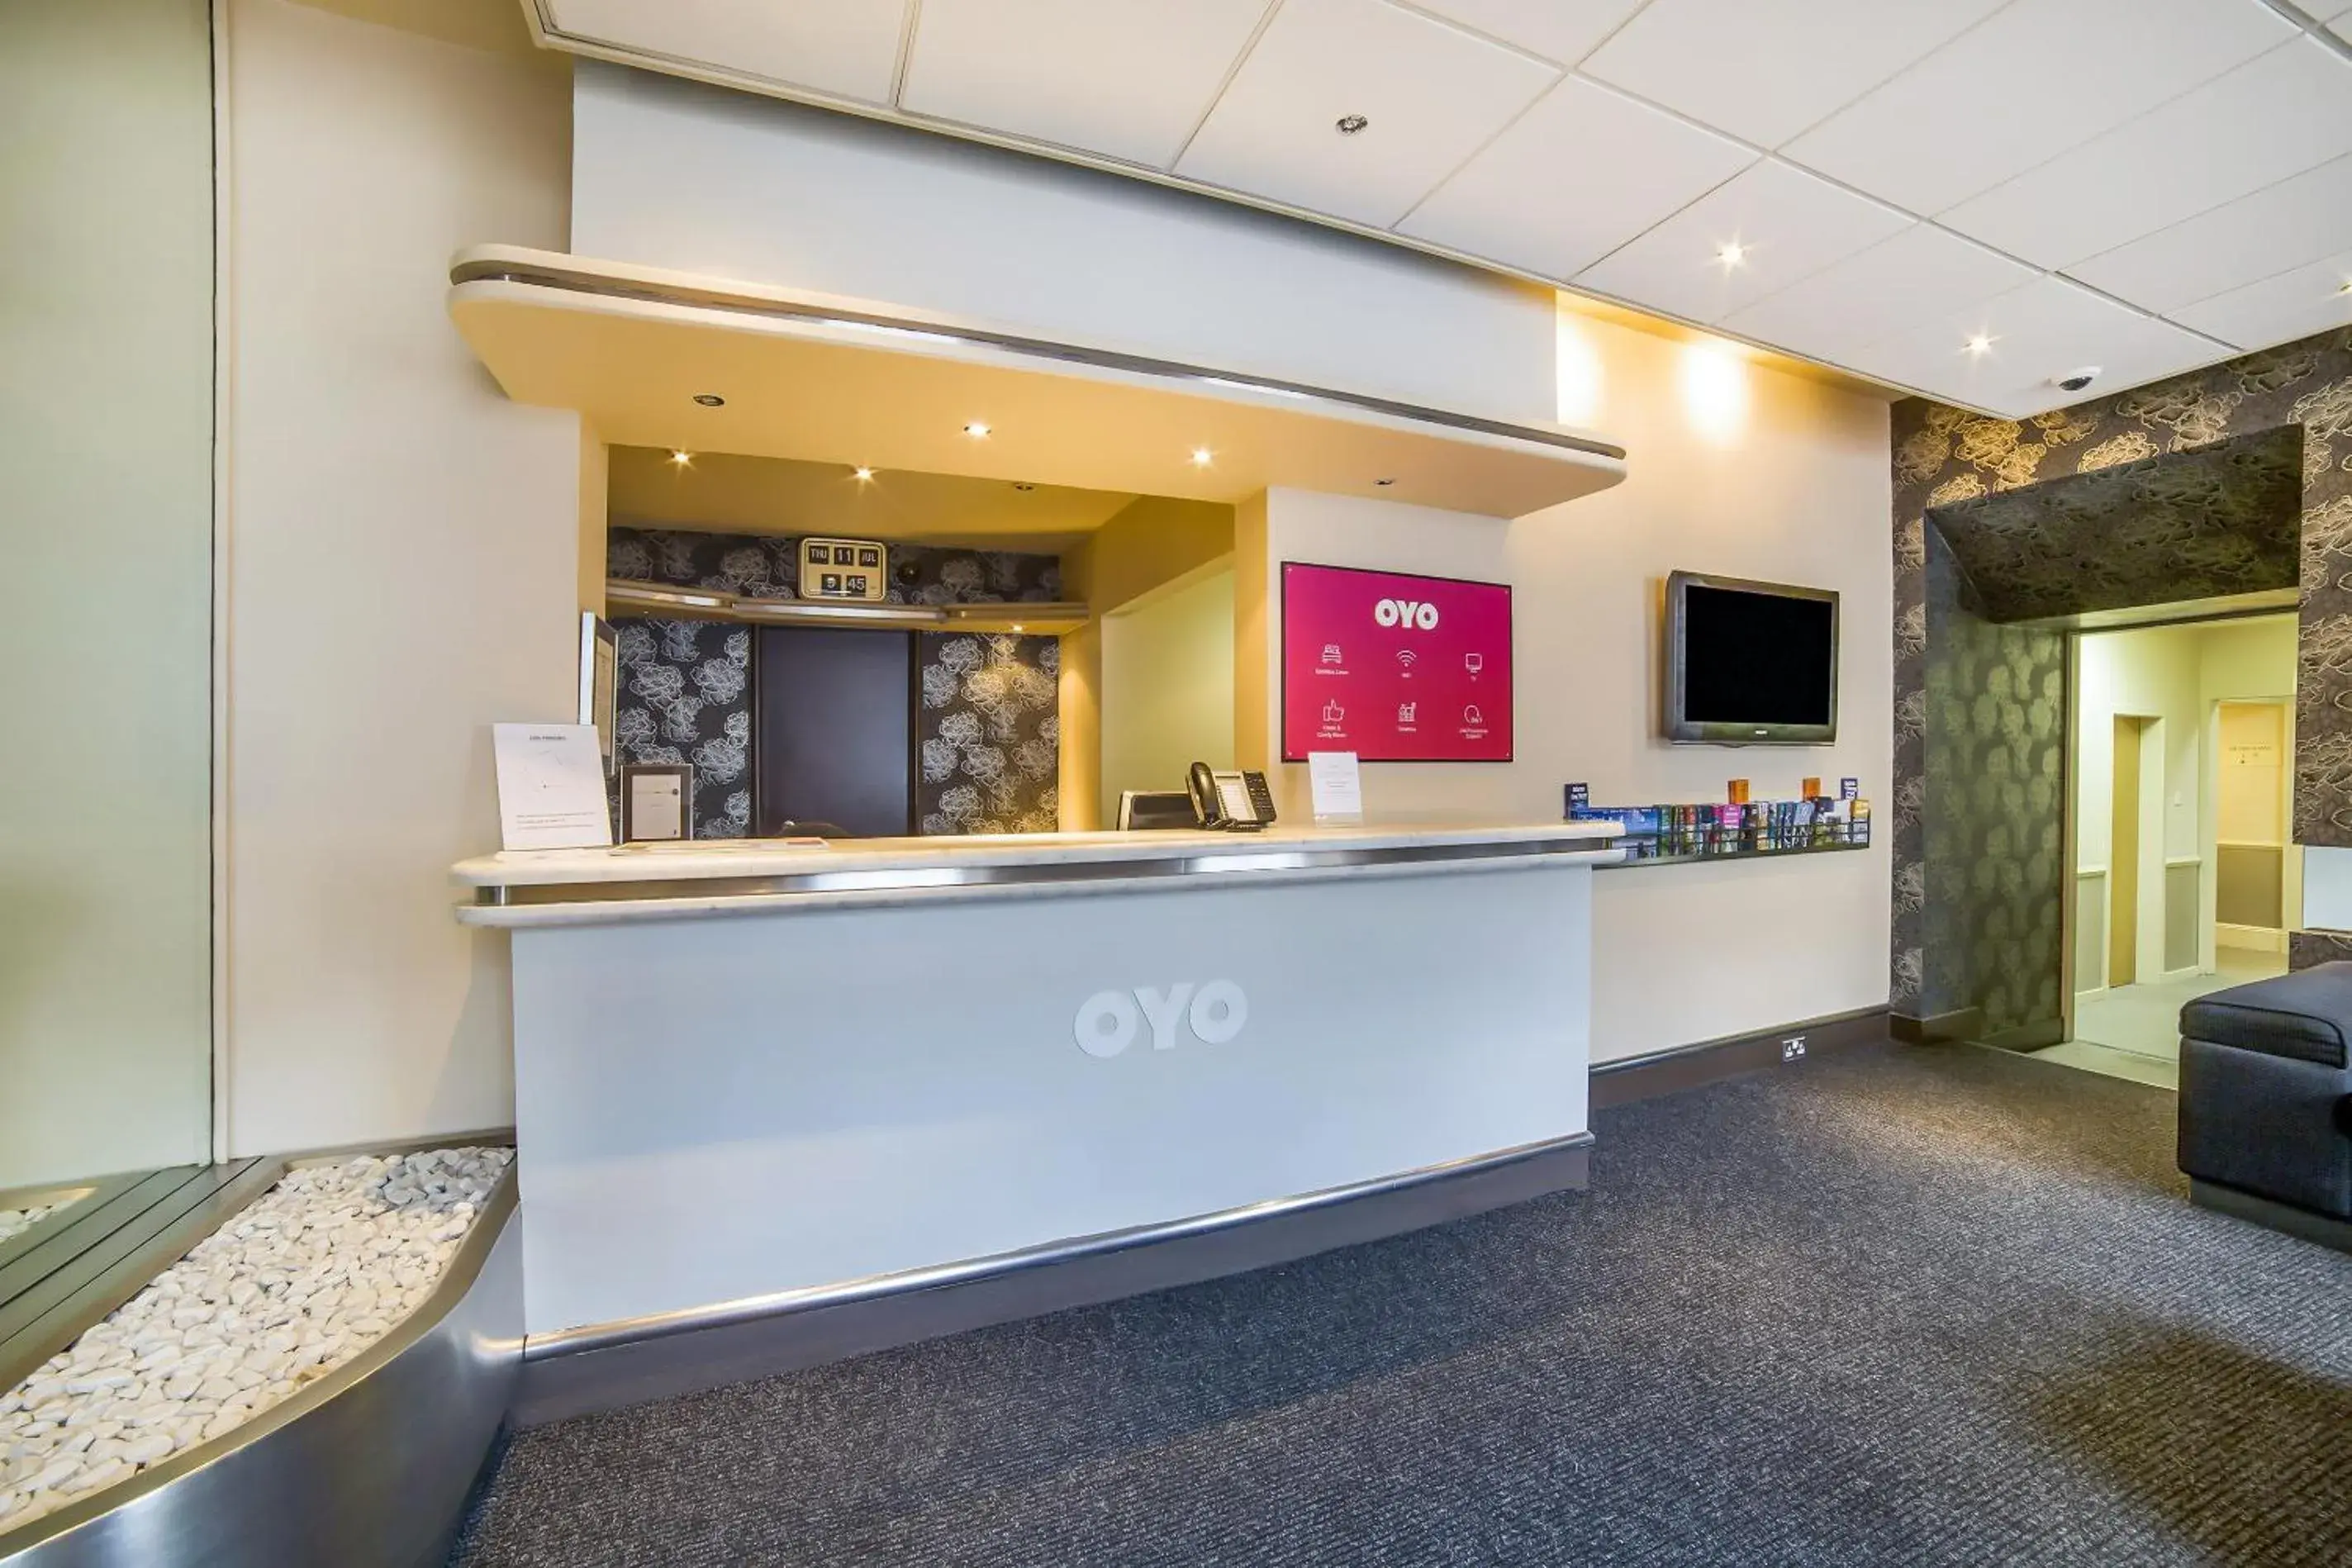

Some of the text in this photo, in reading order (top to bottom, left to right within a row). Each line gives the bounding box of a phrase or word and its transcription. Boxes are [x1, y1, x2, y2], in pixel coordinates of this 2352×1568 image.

[810, 549, 827, 558] THU
[838, 549, 851, 562] 11
[827, 577, 865, 591] 9 45
[1375, 598, 1438, 630] OYO
[1073, 979, 1247, 1058] OYO
